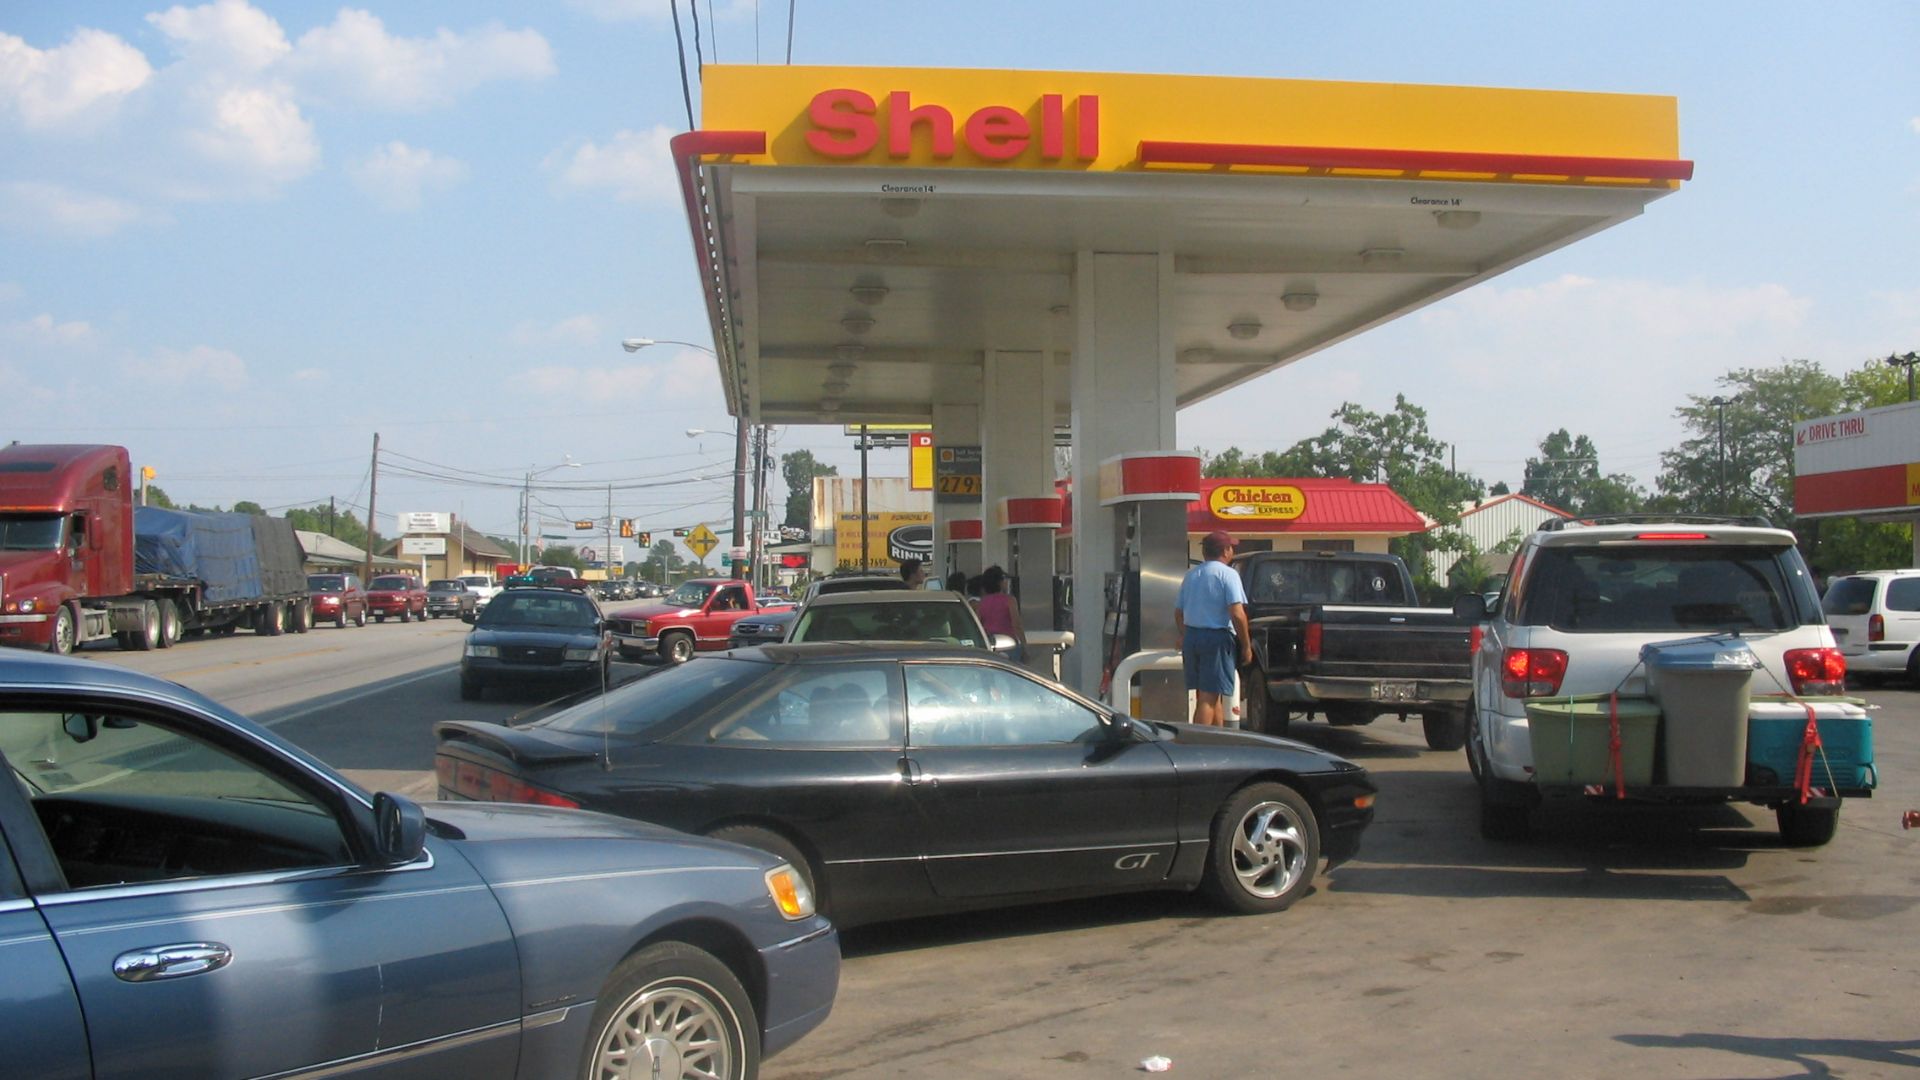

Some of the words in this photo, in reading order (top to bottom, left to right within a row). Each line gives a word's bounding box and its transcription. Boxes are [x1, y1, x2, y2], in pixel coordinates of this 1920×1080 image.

[805, 88, 1099, 161] Shell
[881, 184, 923, 193] Clearance
[1410, 196, 1449, 206] Clearance
[1809, 422, 1837, 441] DRIVE
[1839, 417, 1865, 437] THRU
[1223, 488, 1292, 503] Chicken
[1258, 506, 1294, 514] EXPRESS
[891, 545, 924, 561] RINN
[1114, 852, 1160, 870] GT
